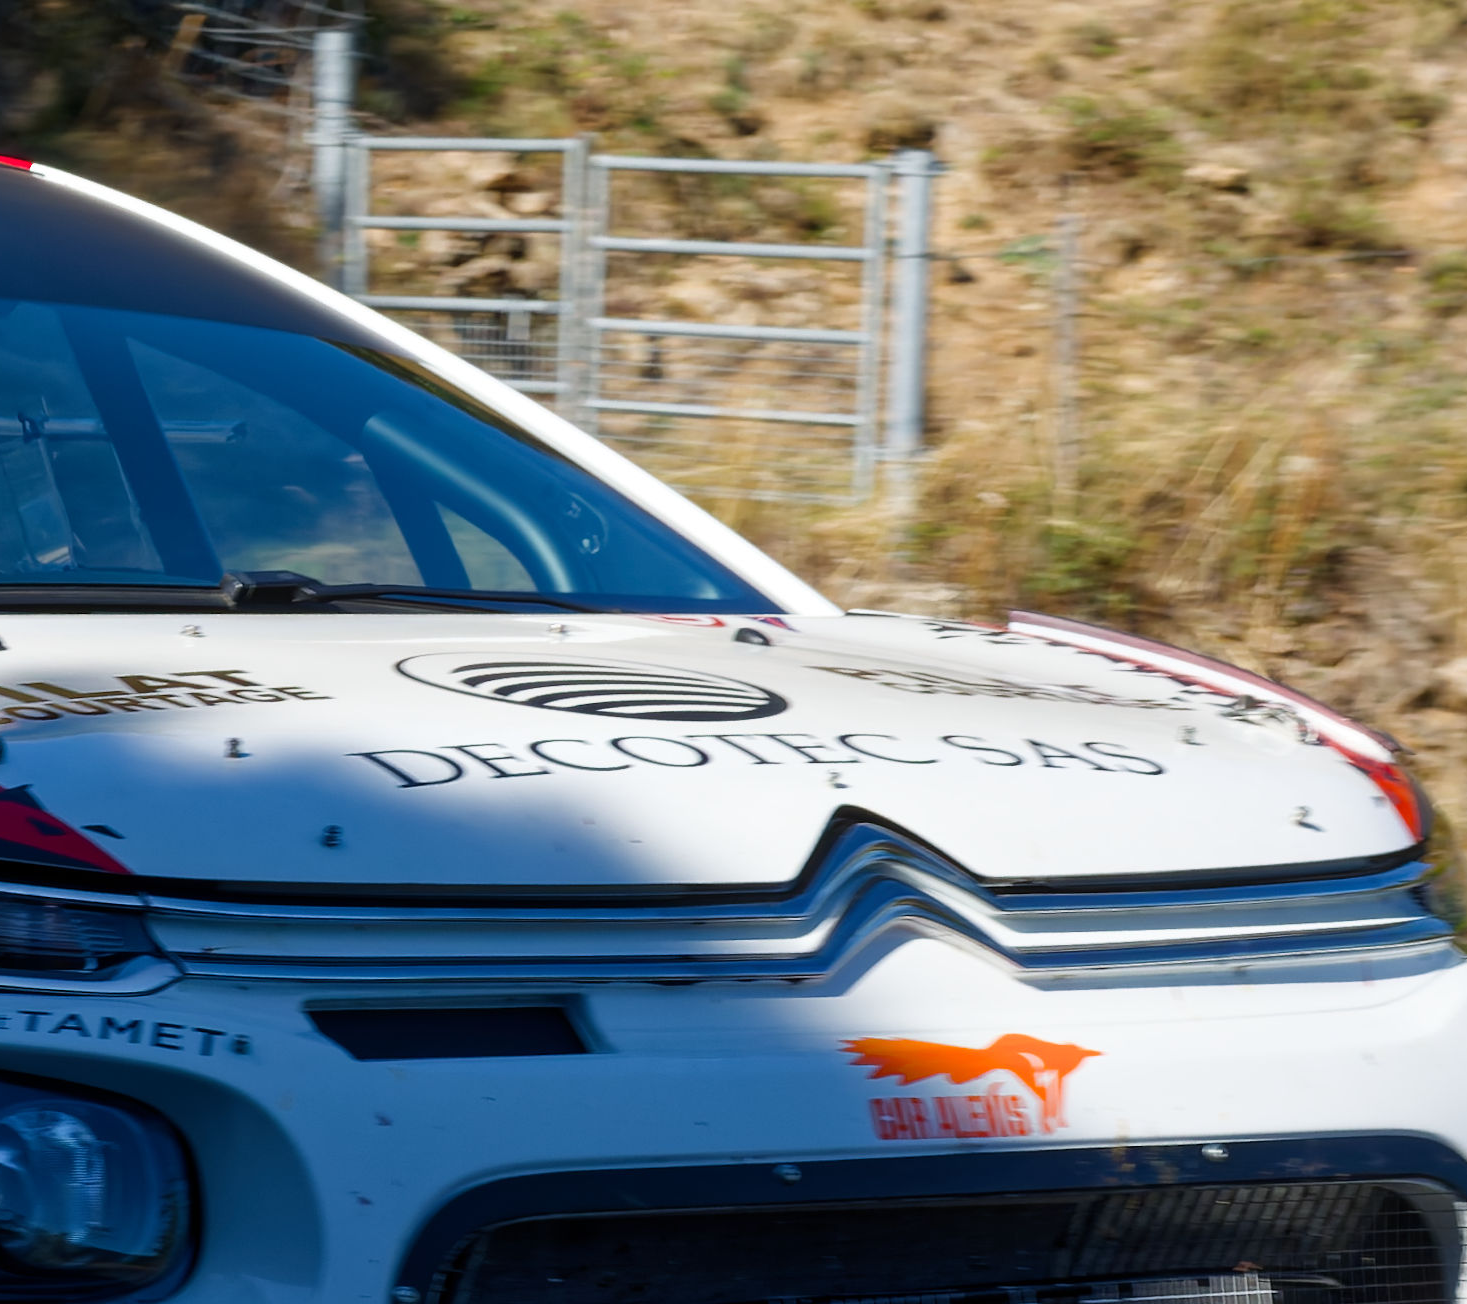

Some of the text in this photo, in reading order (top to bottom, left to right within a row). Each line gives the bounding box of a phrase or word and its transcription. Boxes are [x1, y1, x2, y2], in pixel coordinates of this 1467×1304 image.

[345, 732, 1165, 789] DECOTEC SAS
[16, 1010, 229, 1057] TAMET
